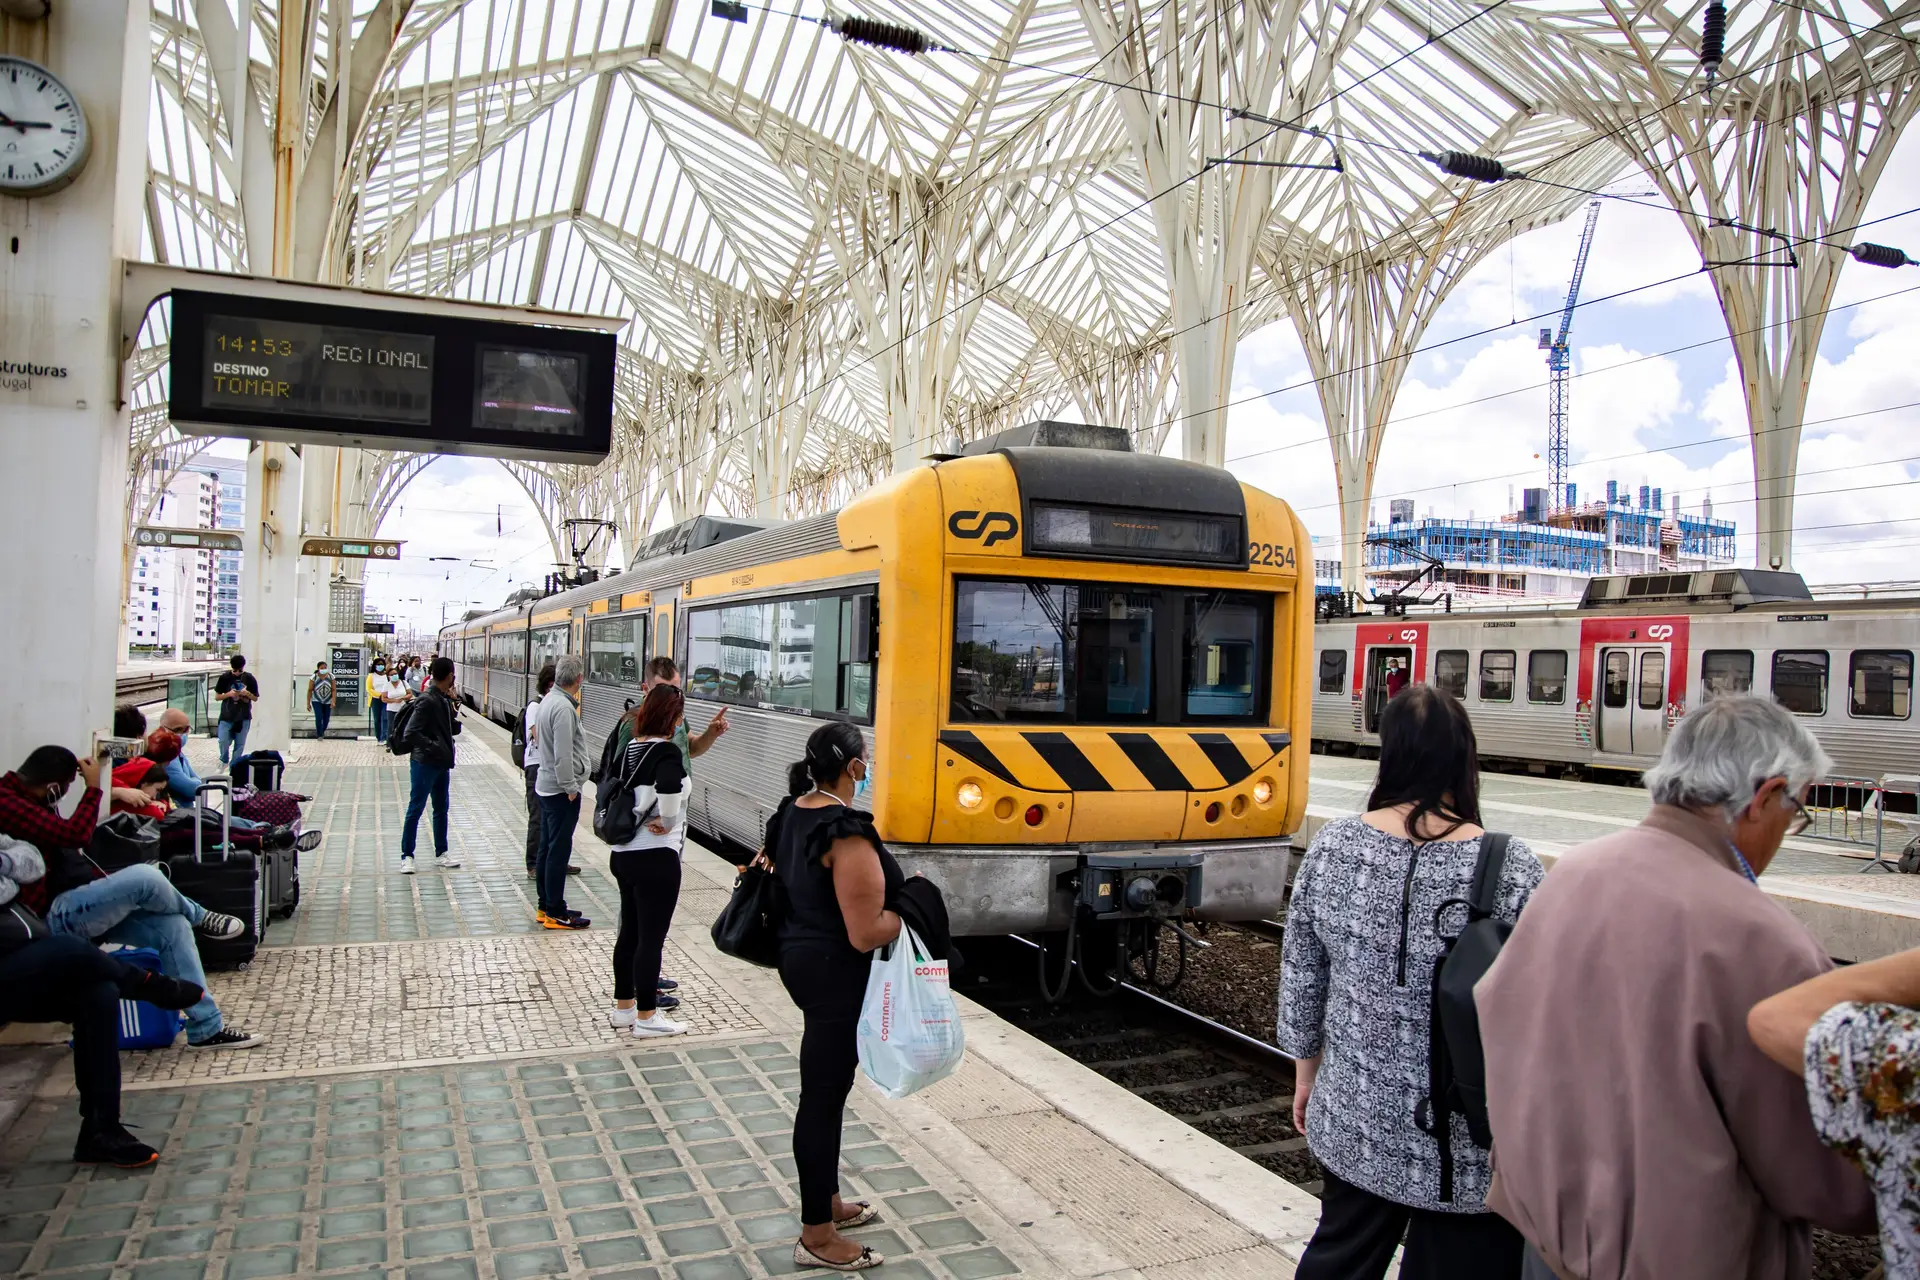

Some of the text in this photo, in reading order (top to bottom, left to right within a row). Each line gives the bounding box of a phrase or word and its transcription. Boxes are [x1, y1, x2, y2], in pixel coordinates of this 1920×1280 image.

[217, 334, 429, 370] 14:53 REGIONAL
[213, 362, 269, 377] DESTINO
[0, 378, 32, 392] ugal
[213, 375, 291, 398] TOMAR
[948, 510, 1019, 547] CP
[1249, 541, 1296, 569] 2254
[1400, 629, 1418, 643] CP
[1648, 624, 1673, 641] CP
[881, 981, 891, 1041] CONTINENTE
